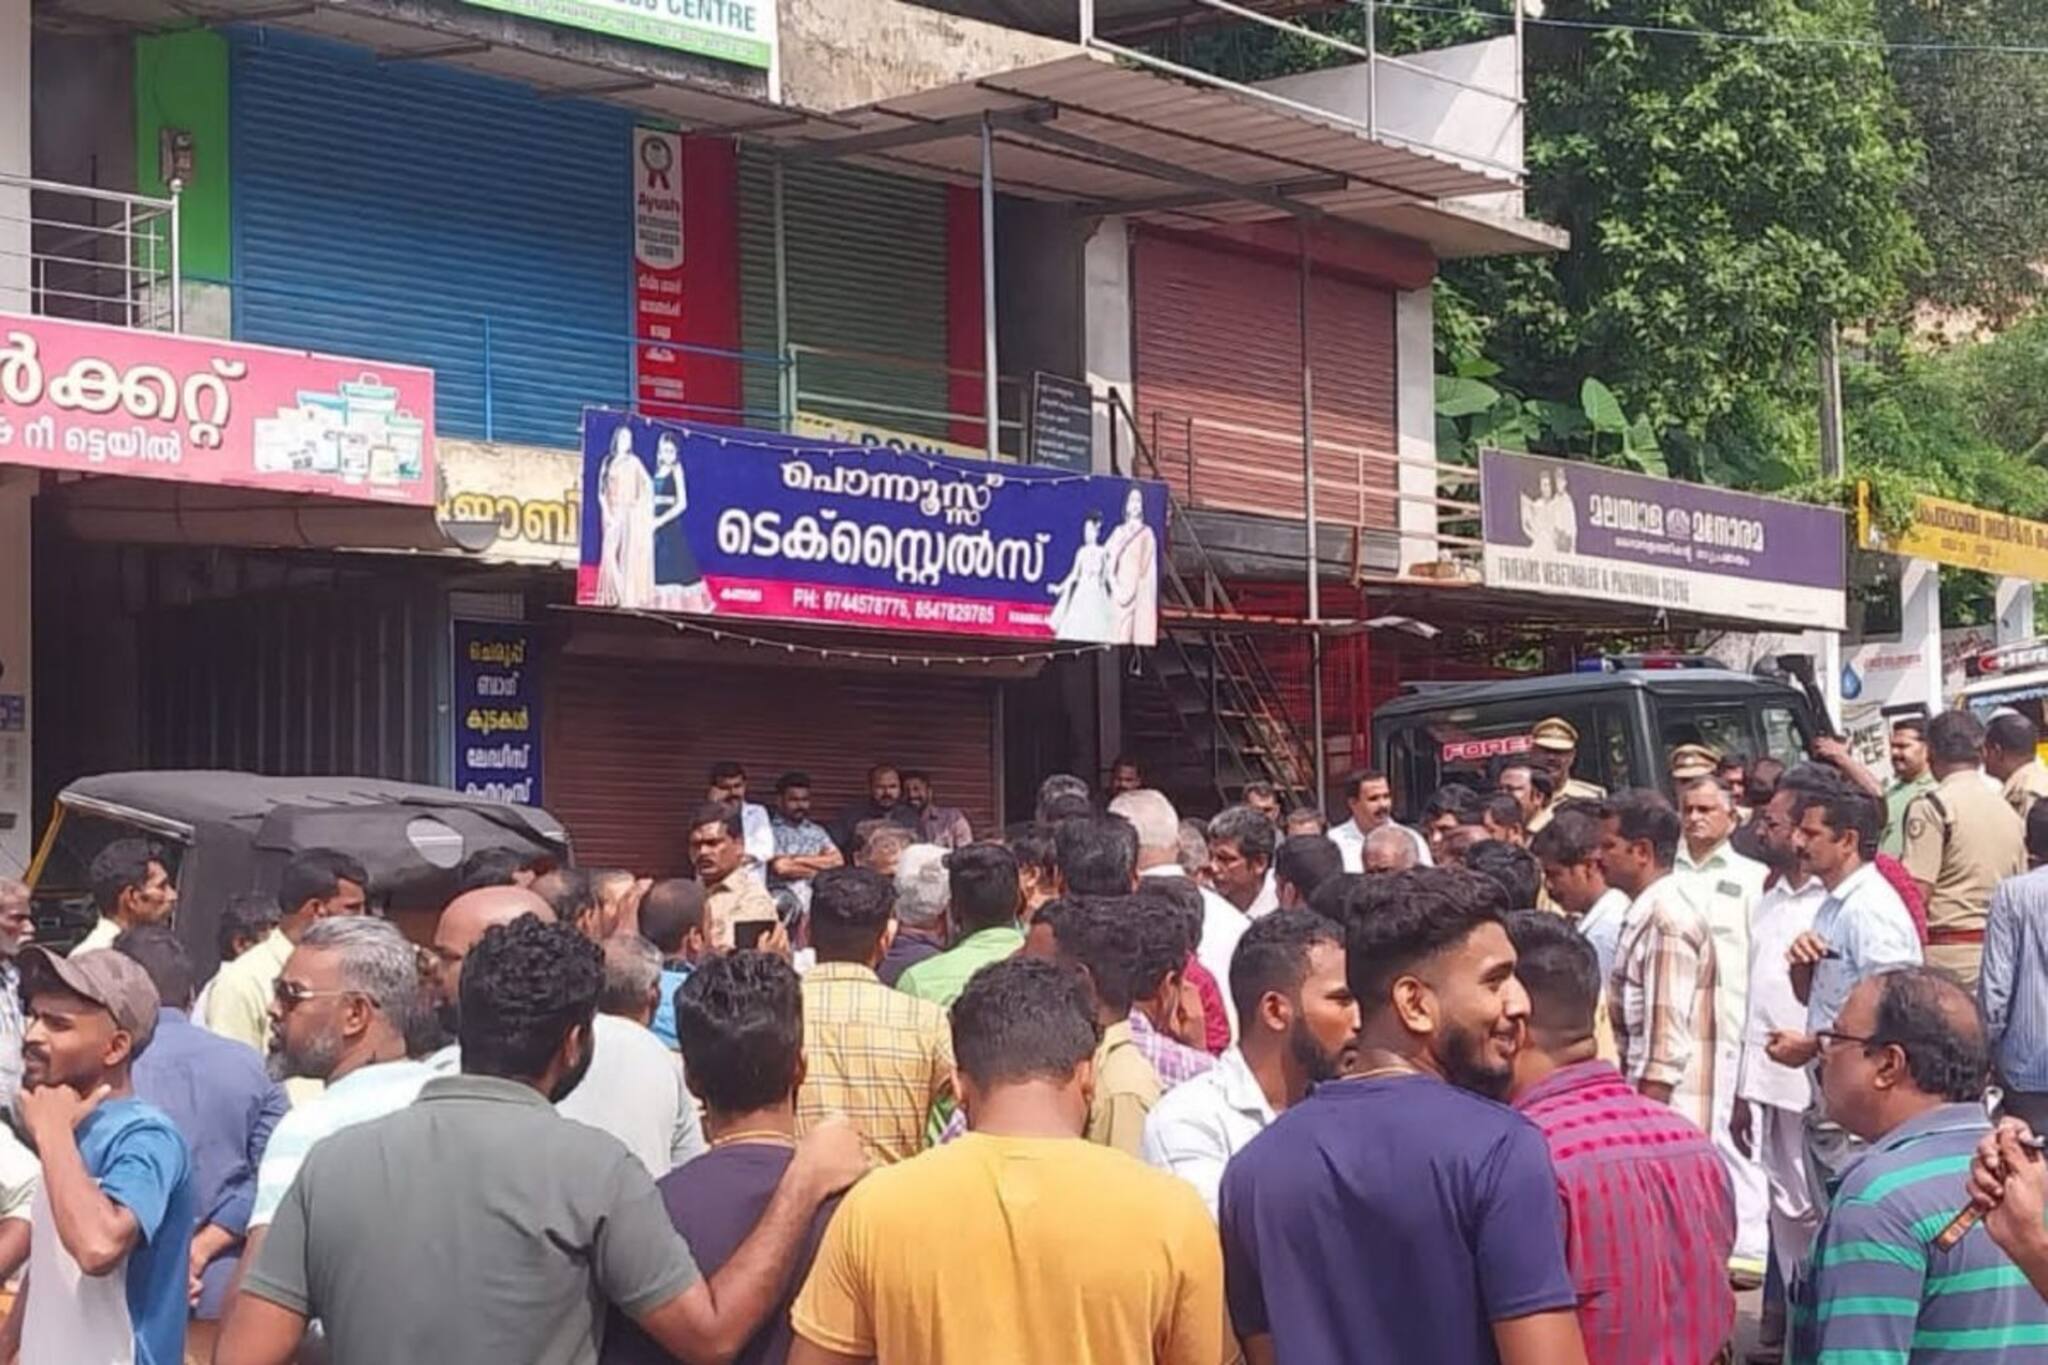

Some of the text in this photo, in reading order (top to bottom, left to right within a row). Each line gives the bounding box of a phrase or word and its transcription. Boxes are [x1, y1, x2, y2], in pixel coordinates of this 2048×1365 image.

[667, 0, 757, 32] CENTRE
[639, 192, 681, 214] Ayush
[792, 588, 820, 610] PH:
